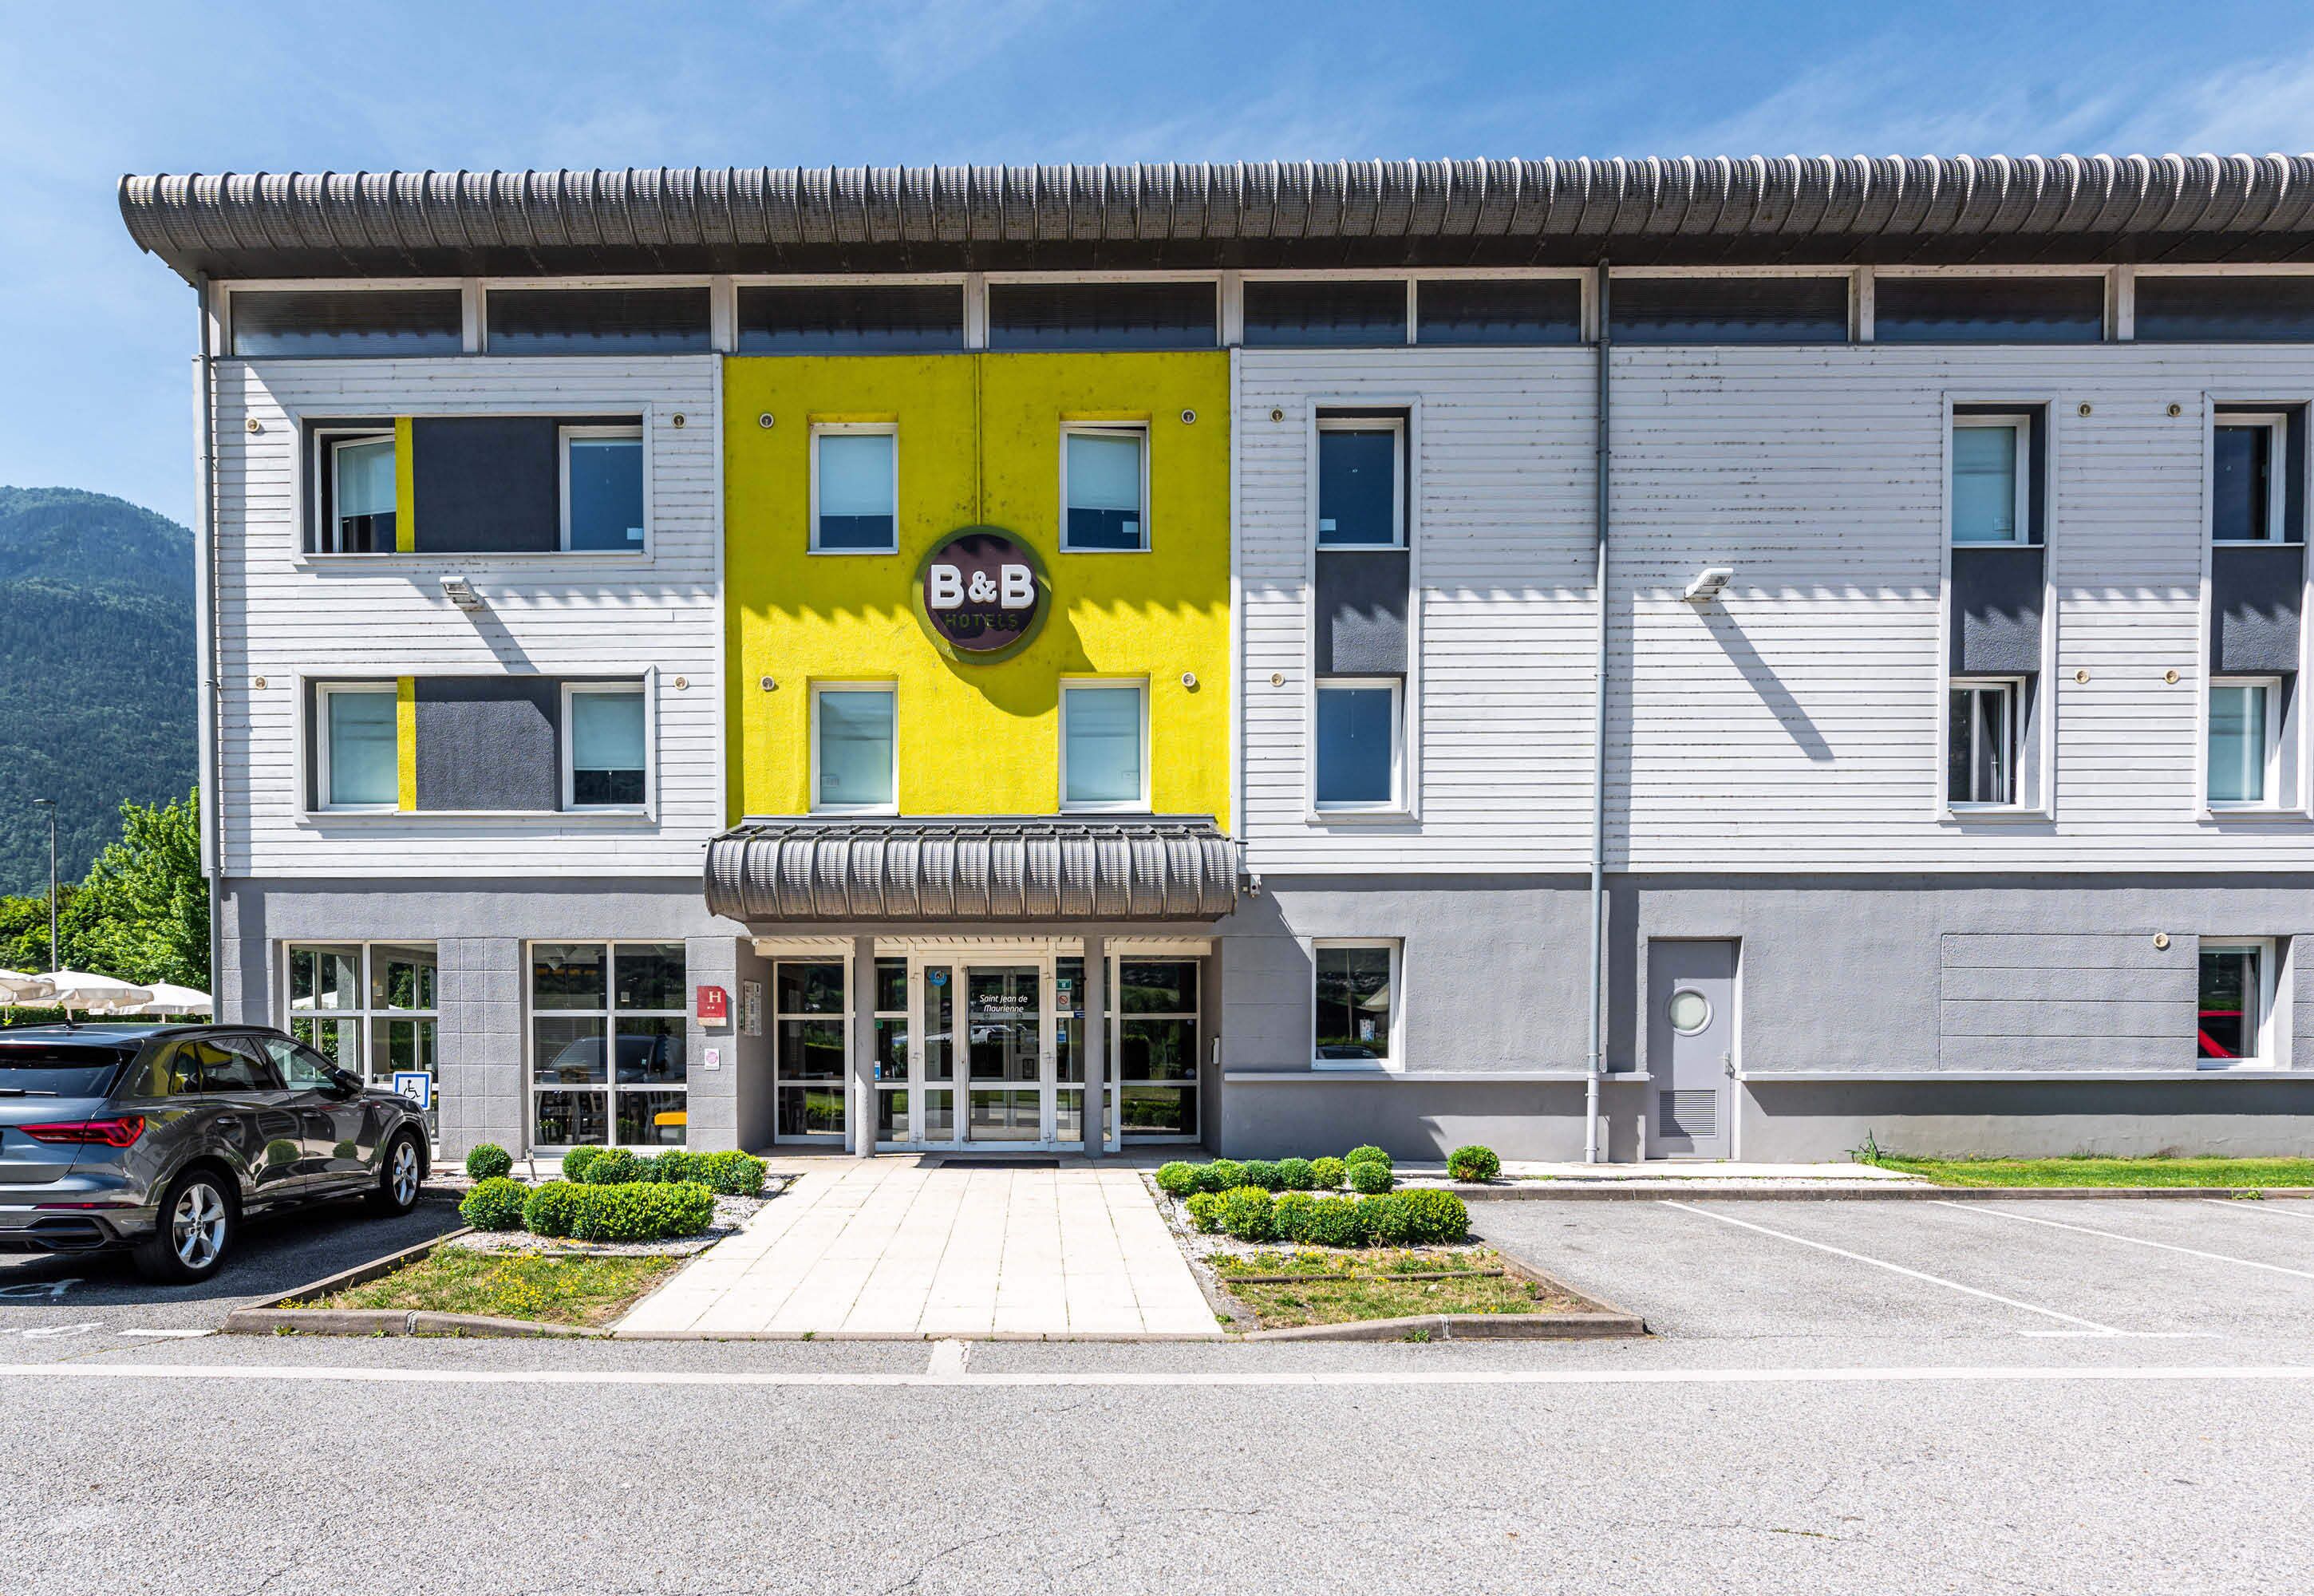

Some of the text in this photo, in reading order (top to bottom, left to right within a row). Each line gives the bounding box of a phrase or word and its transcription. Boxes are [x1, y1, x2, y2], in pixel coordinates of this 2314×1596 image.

[930, 564, 1035, 610] B&B
[945, 614, 1018, 630] HOTELS
[709, 991, 722, 1003] H
[999, 995, 1017, 1004] Jean
[983, 1004, 1025, 1013] Maurienne
